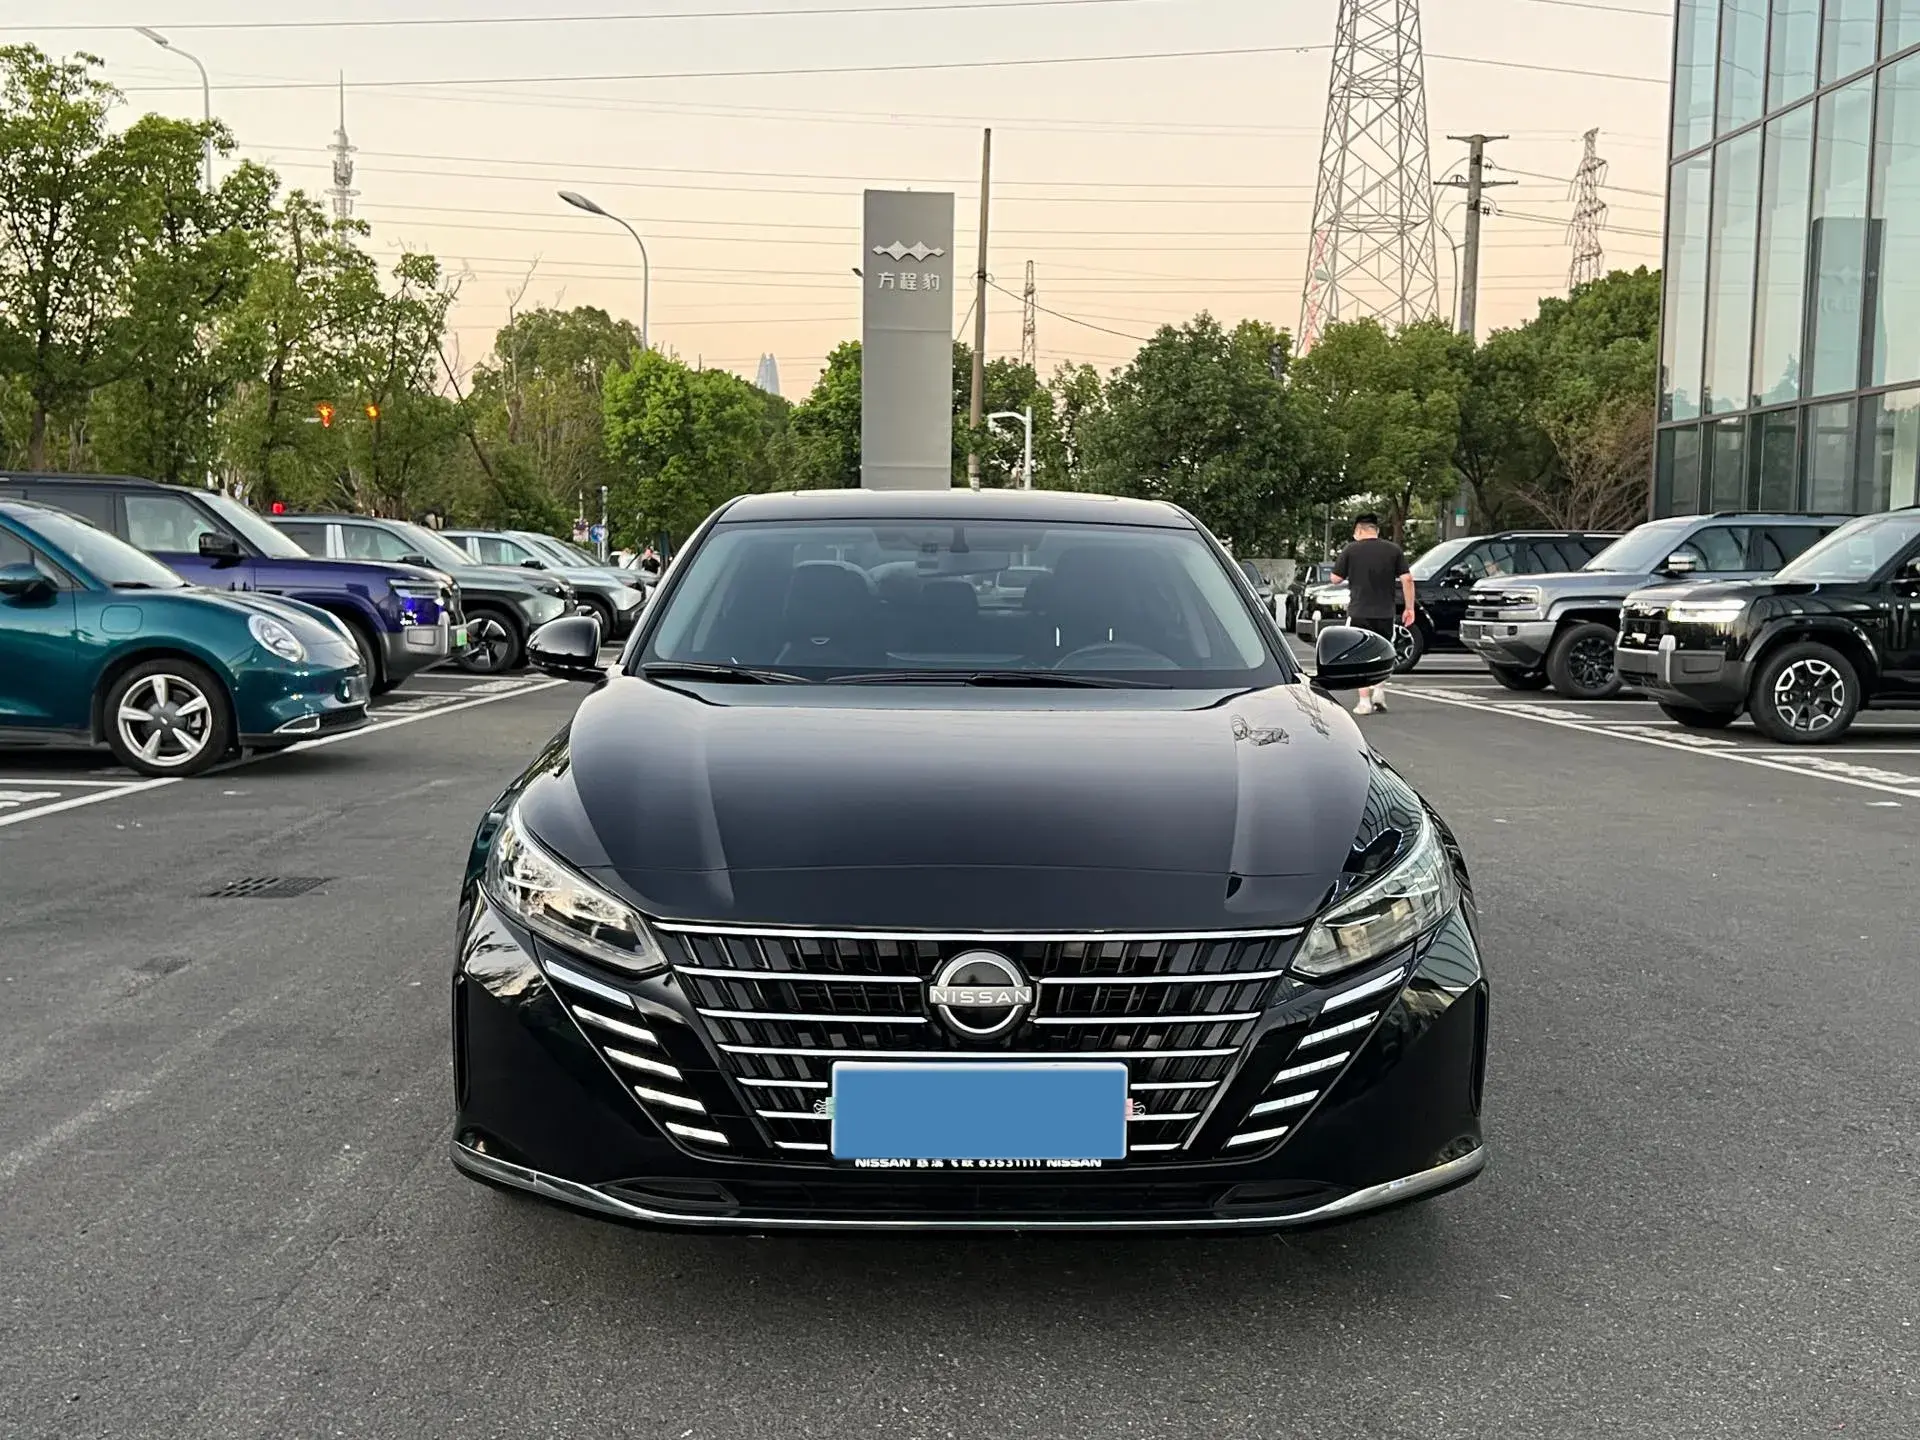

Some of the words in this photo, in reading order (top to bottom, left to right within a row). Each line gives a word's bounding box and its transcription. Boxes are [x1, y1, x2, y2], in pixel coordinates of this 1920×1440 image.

[878, 271, 941, 292] 方程豹
[931, 989, 1031, 1005] NISSAN
[854, 1158, 911, 1168] NISSAN
[1046, 1158, 1102, 1168] NISSAN
